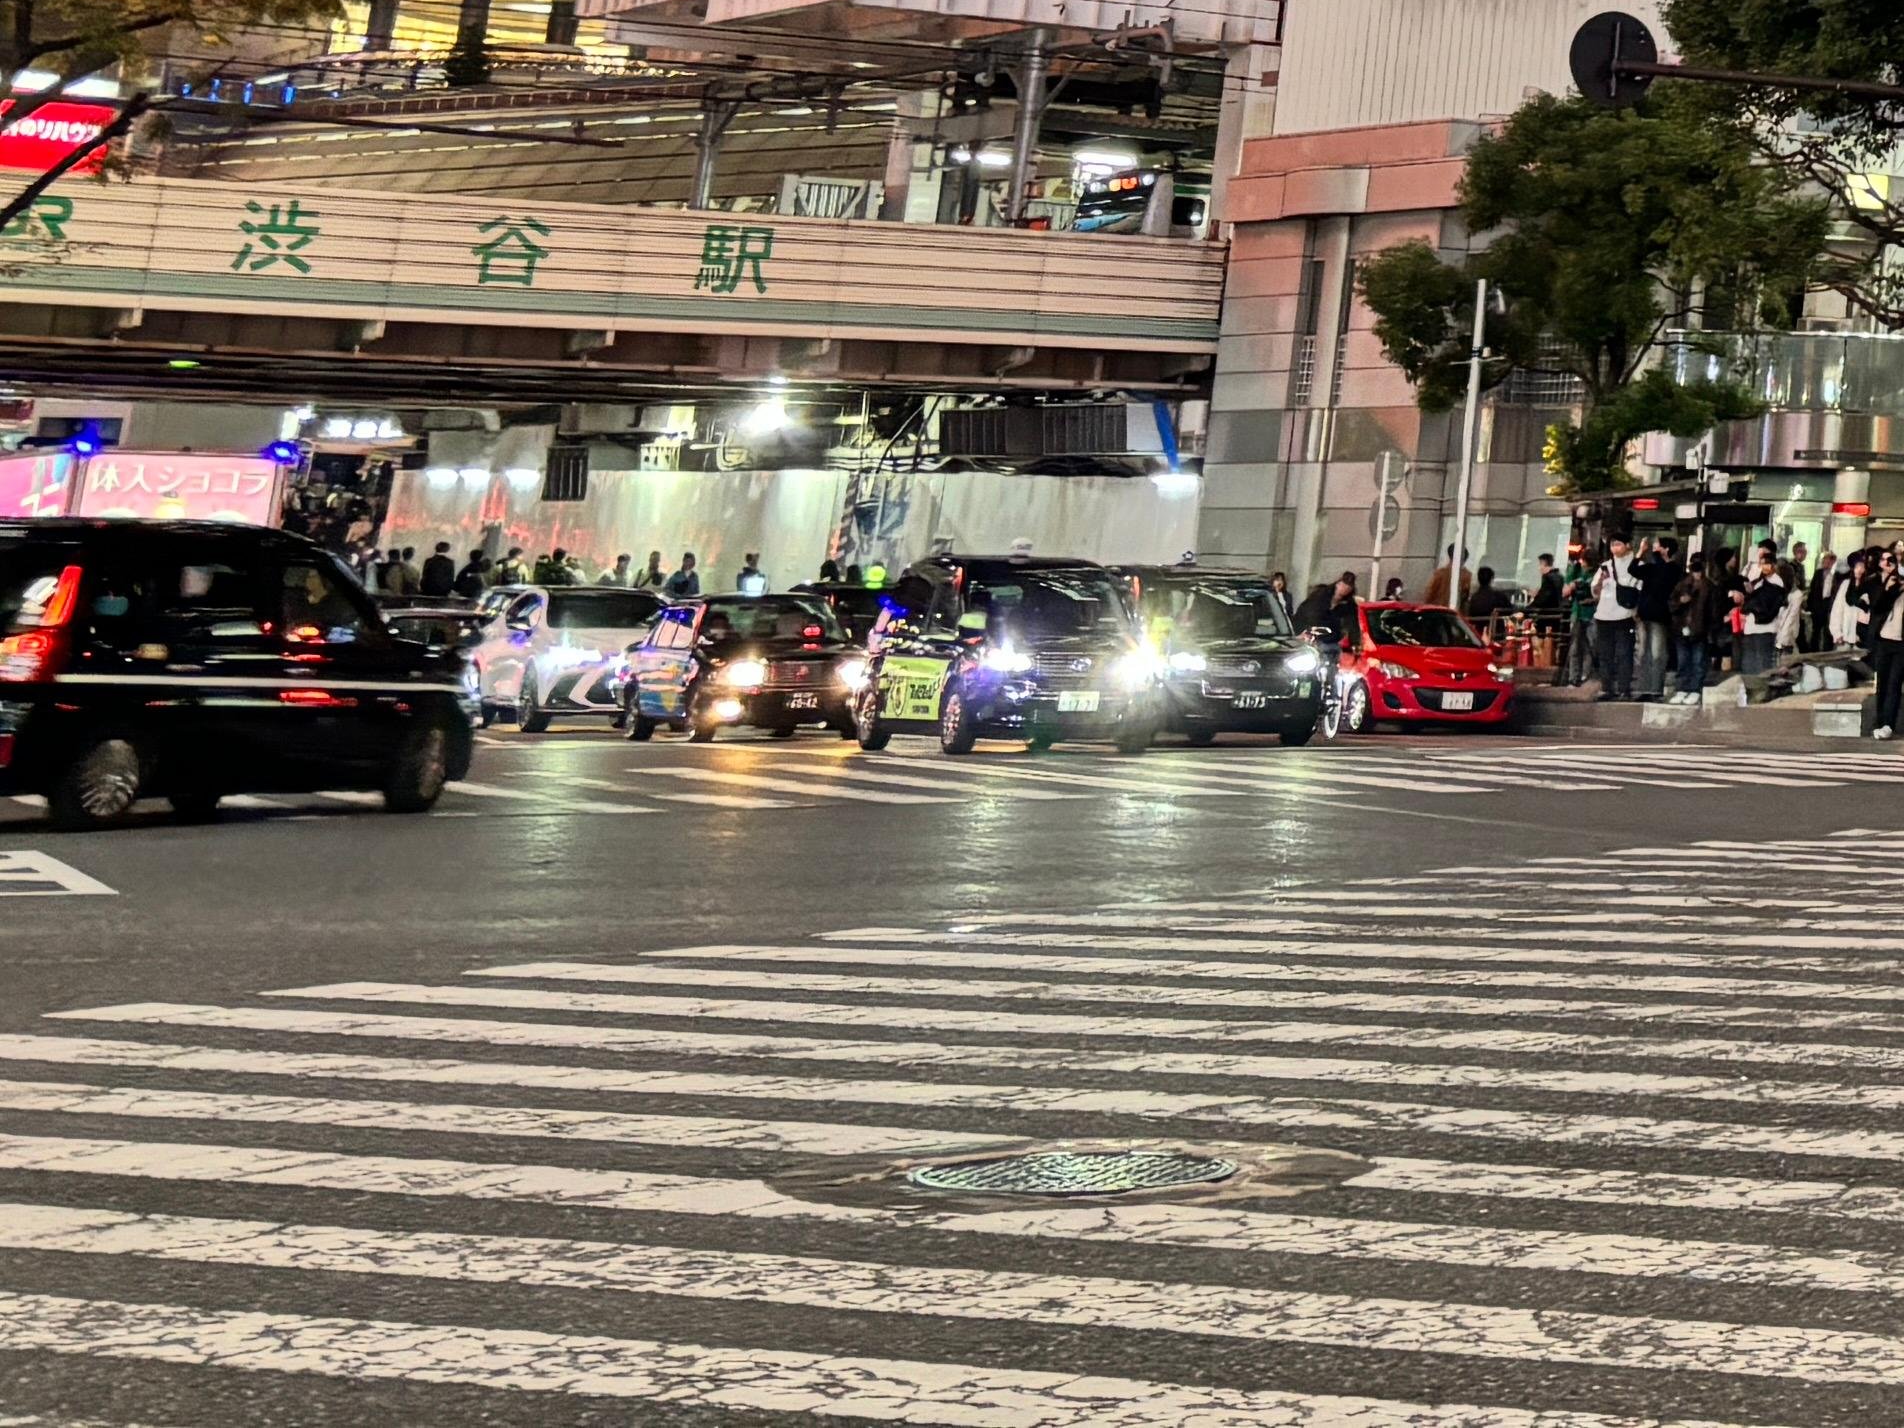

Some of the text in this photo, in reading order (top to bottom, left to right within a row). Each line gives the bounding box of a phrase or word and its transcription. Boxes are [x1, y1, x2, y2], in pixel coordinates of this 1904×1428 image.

[231, 199, 777, 295] 渋谷駅
[91, 462, 269, 495] 体入ショコラ
